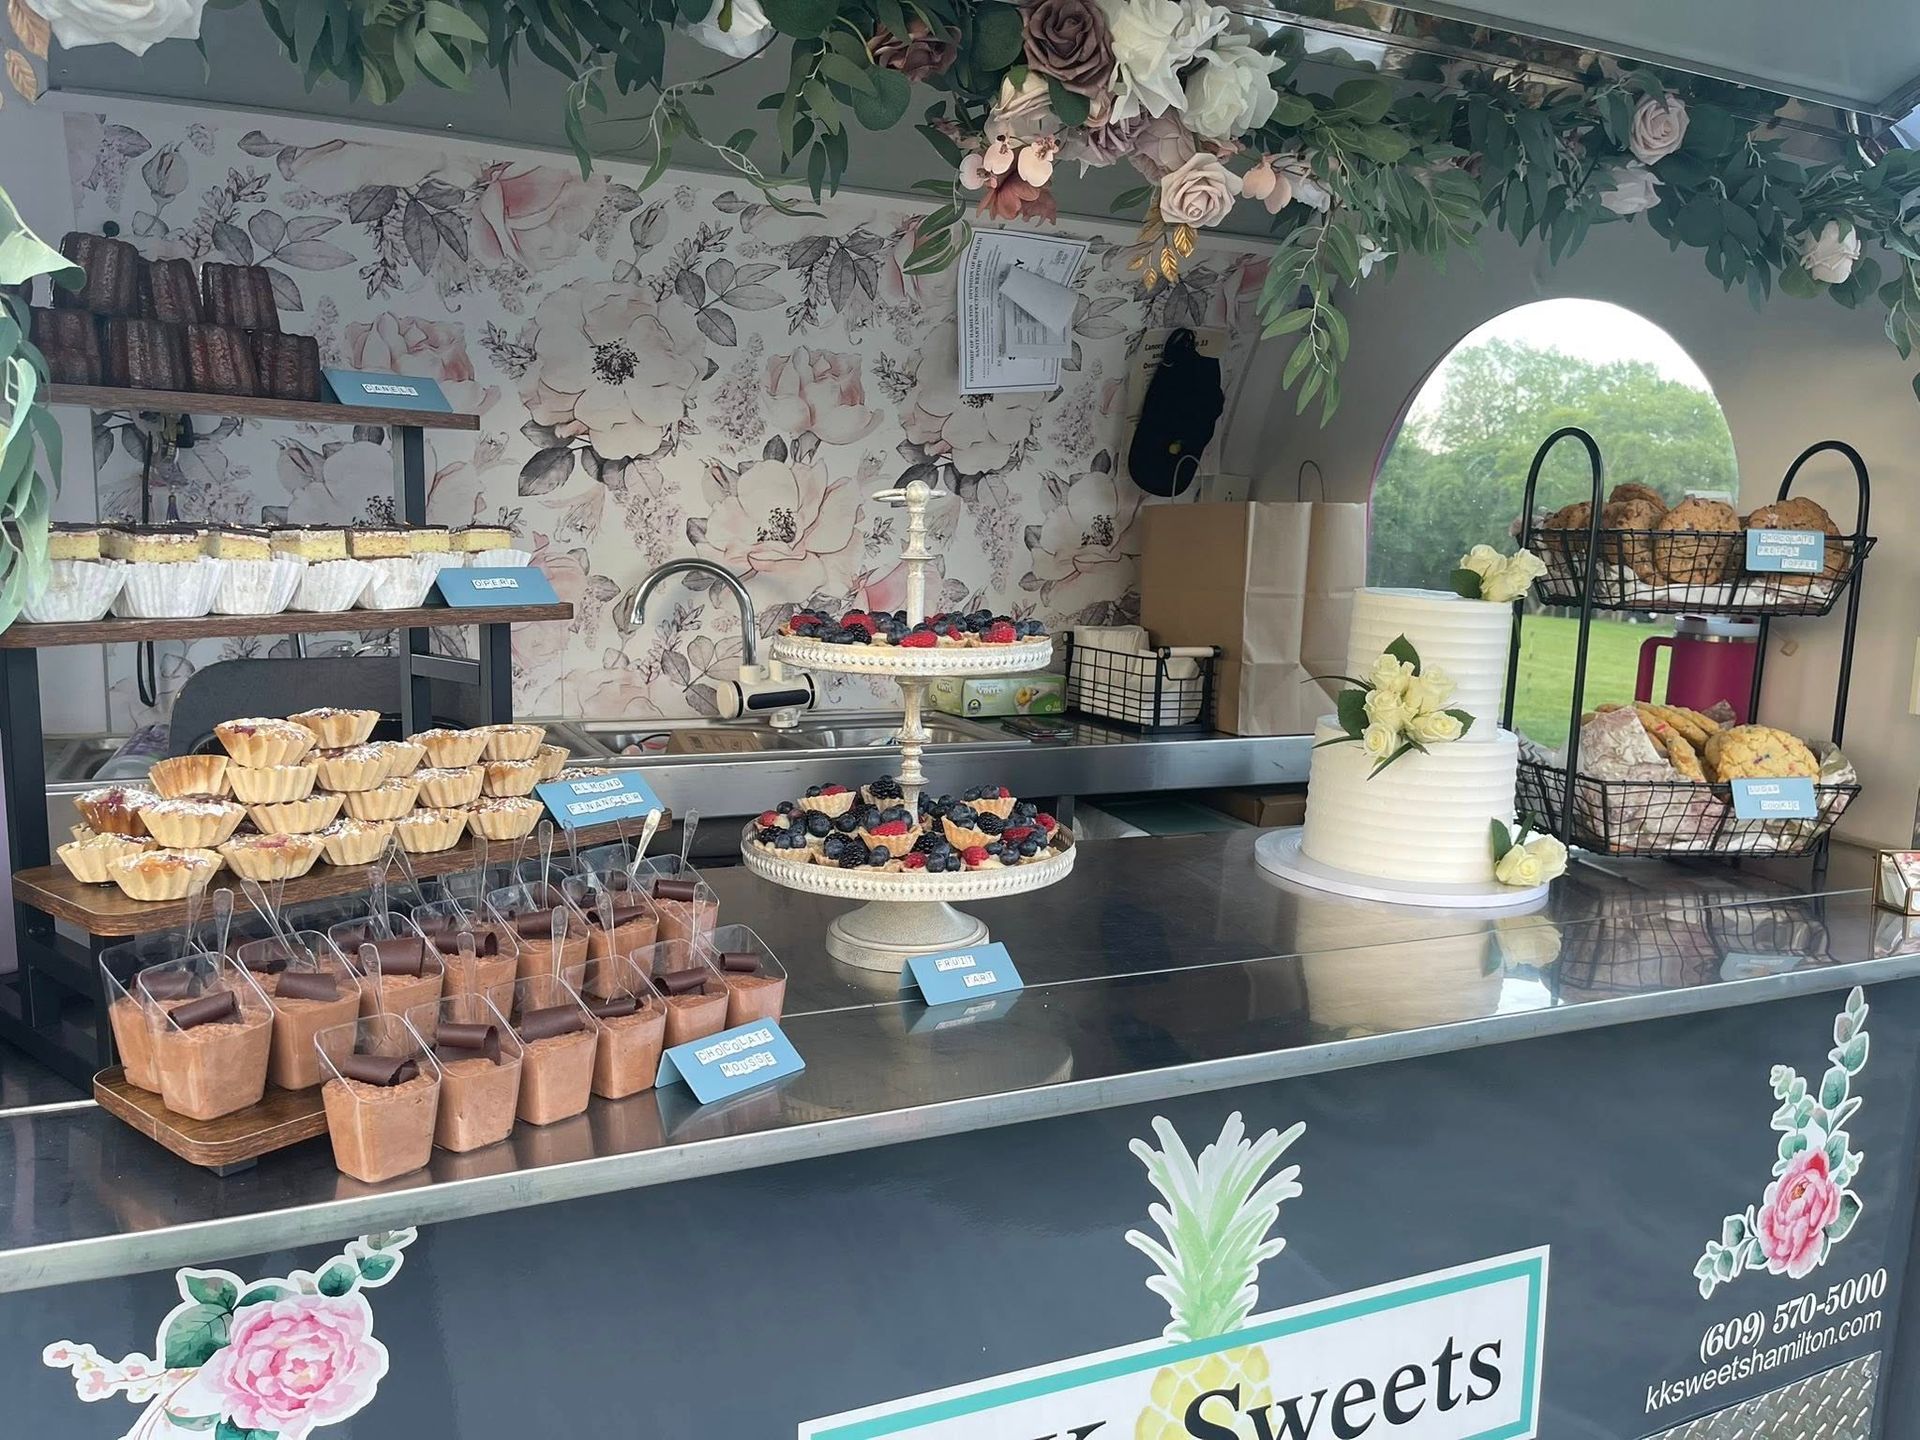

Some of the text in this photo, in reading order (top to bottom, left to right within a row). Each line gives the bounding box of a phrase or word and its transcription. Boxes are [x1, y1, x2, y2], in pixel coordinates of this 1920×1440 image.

[974, 260, 983, 285] REPORT
[364, 383, 417, 395] CANELE
[1761, 534, 1814, 544] CHOCOLATE
[1782, 560, 1817, 569] TOFFEE
[473, 579, 516, 588] OPERA
[573, 779, 622, 792] ALMOND
[569, 794, 641, 813] FINANCIER
[1761, 801, 1798, 809] COOKIE
[936, 956, 973, 968] FRUIT
[965, 972, 994, 984] TART
[698, 1029, 772, 1062] CHOCOLATE
[722, 1053, 773, 1073] MOUSSE
[1700, 1268, 1887, 1364] (609) 570-5000
[1644, 1310, 1882, 1413] kksweetshamilton.com
[1184, 1335, 1502, 1440] Sweets
